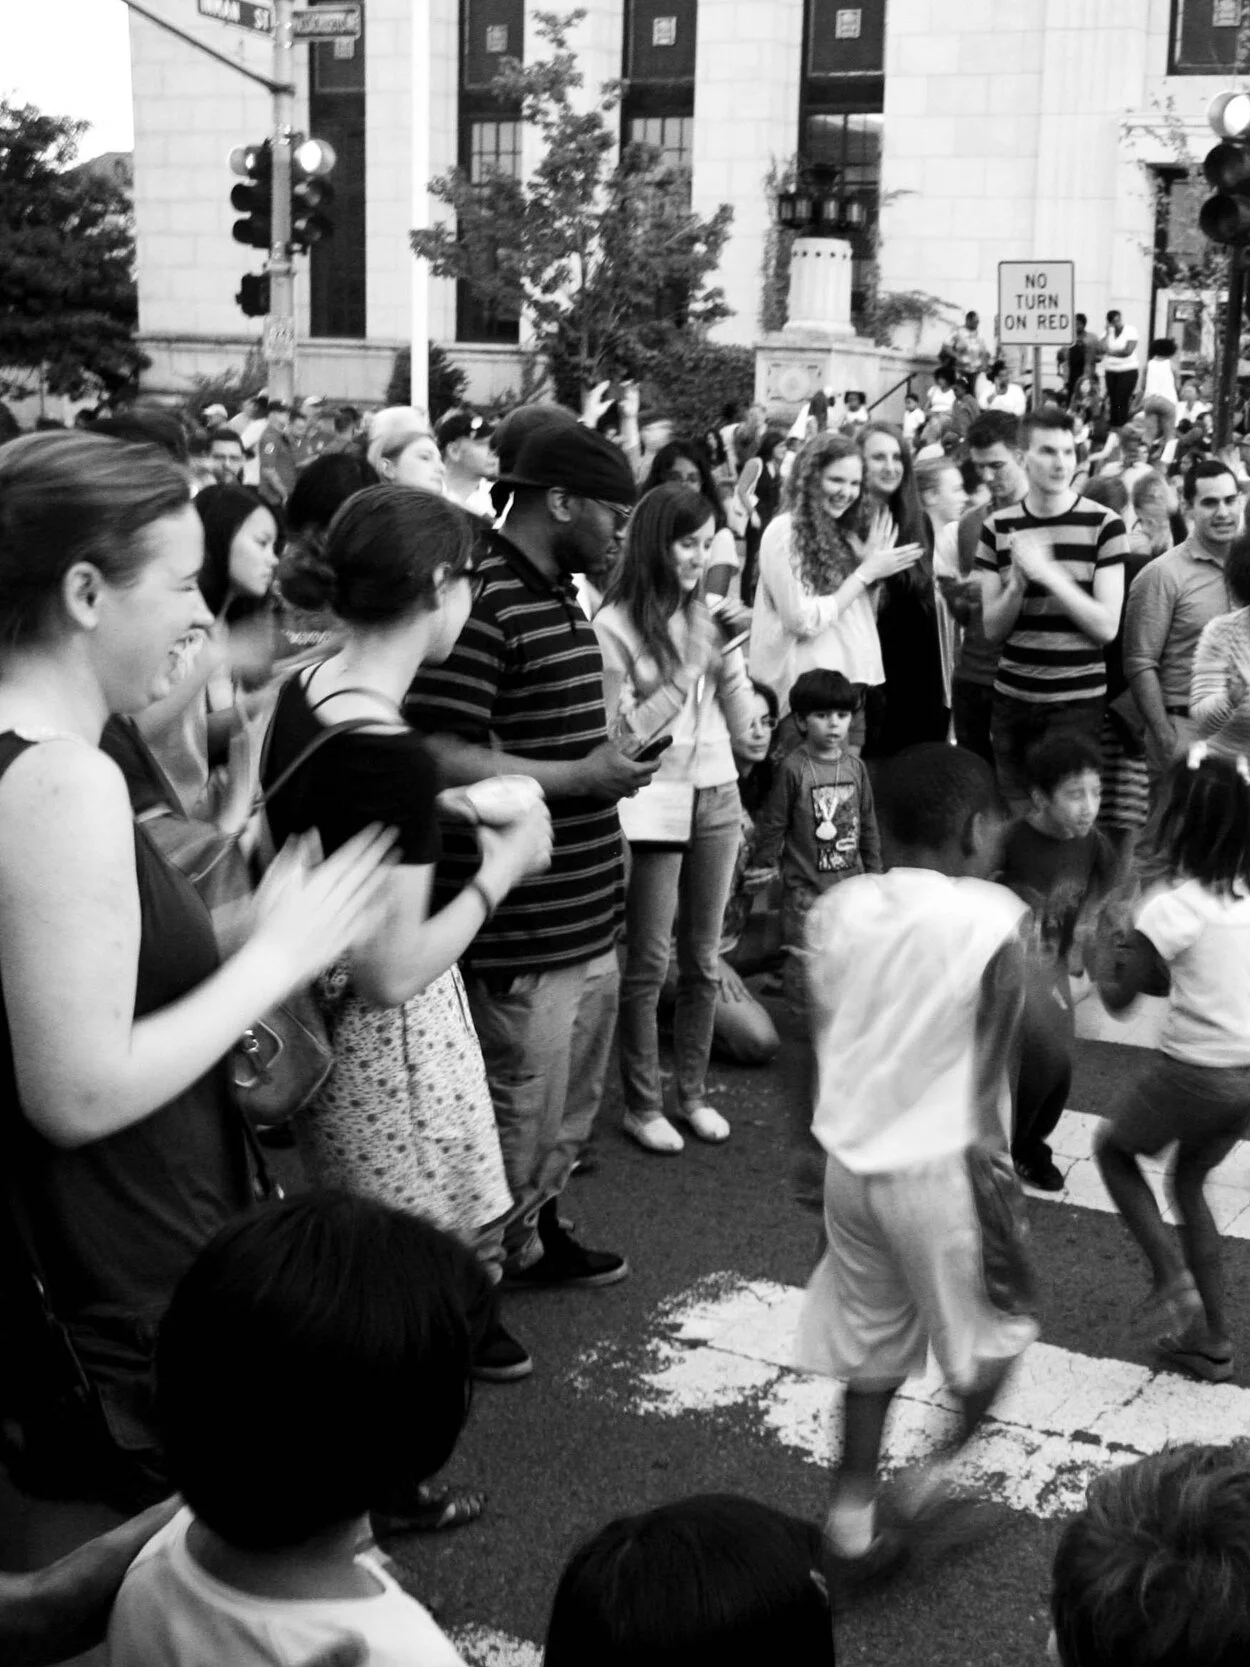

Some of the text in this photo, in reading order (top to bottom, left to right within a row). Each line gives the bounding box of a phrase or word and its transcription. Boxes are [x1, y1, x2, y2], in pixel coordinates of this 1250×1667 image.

[1025, 273, 1047, 289] NO
[1016, 294, 1059, 310] TURN
[1004, 314, 1069, 330] ON RED
